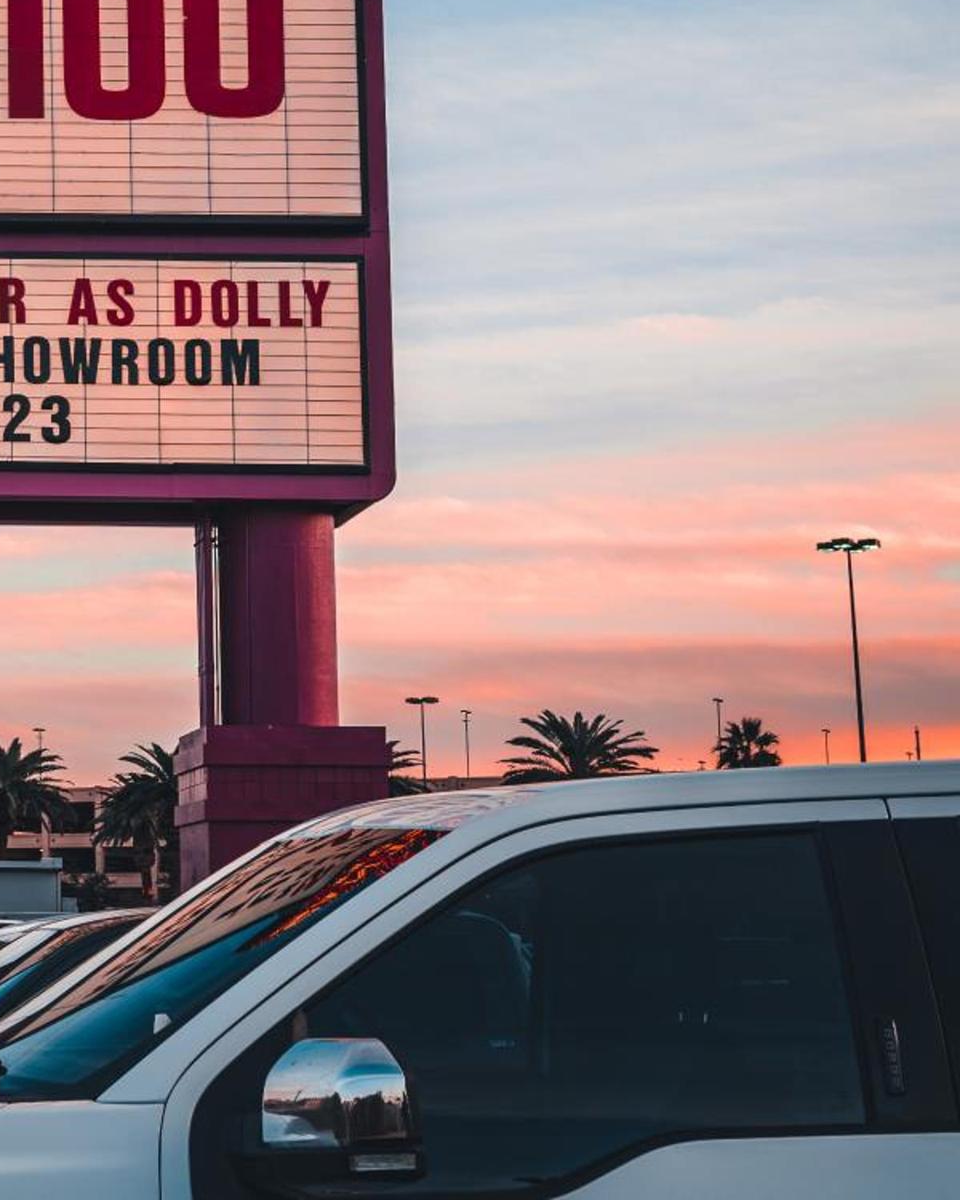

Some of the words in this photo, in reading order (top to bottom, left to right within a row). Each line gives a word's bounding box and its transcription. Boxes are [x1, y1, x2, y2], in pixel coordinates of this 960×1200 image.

[68, 278, 136, 327] AS
[173, 280, 331, 328] DOLLY
[3, 394, 72, 444] 23
